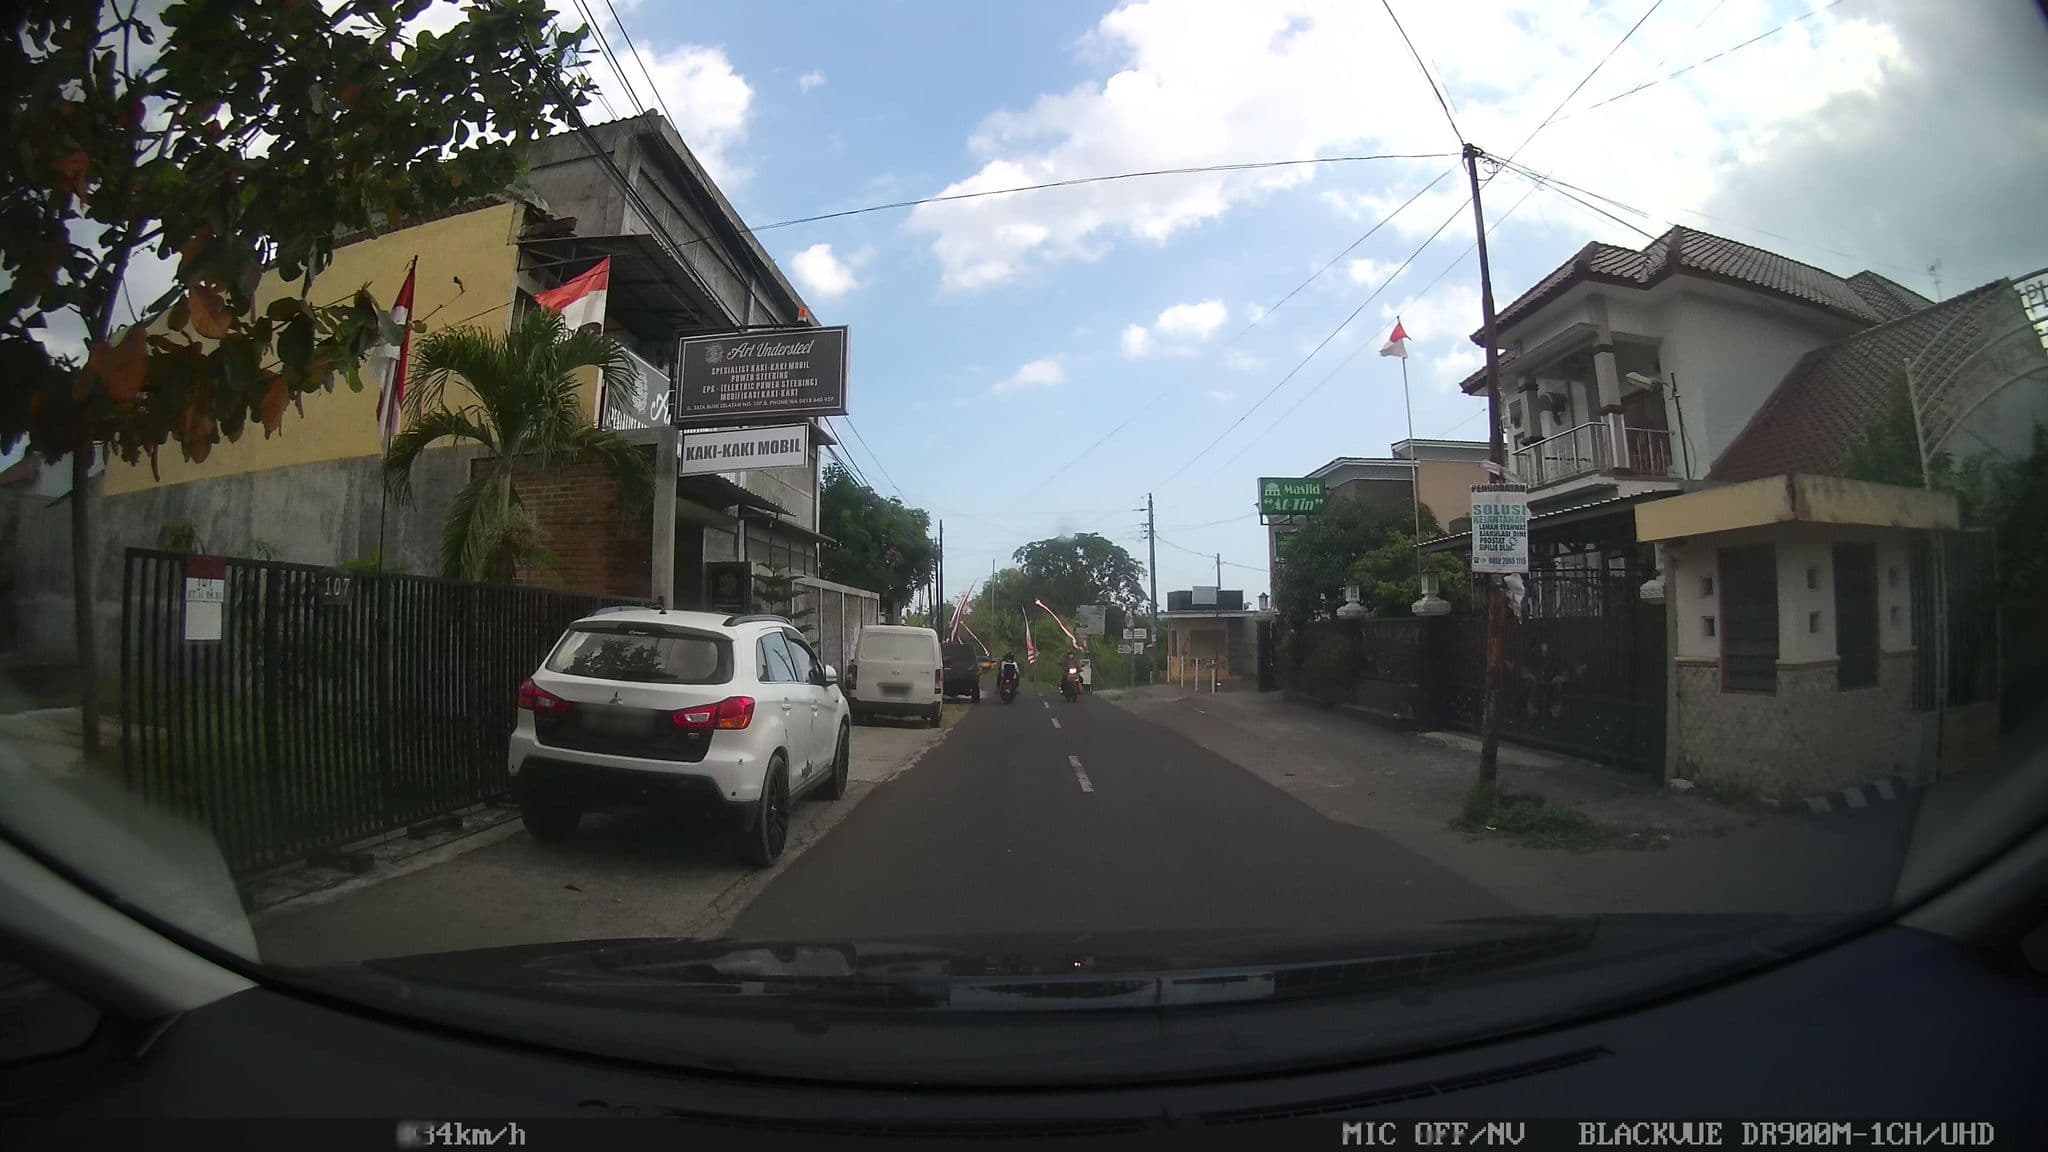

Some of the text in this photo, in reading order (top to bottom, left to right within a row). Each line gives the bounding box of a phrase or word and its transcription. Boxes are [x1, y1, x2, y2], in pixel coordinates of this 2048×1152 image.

[727, 340, 815, 360] Art Understeel
[750, 362, 788, 373] KAKI-KAKI
[788, 362, 810, 371] MOBIL
[731, 372, 788, 382] POWER STEERING
[756, 381, 780, 390] POWER
[761, 388, 798, 399] KAKI-KAKI
[686, 438, 801, 460] KAKI-KAKI MOBIL
[1285, 484, 1320, 495] Masjid
[1473, 505, 1526, 514] SOLUSI
[324, 577, 351, 596] 107
